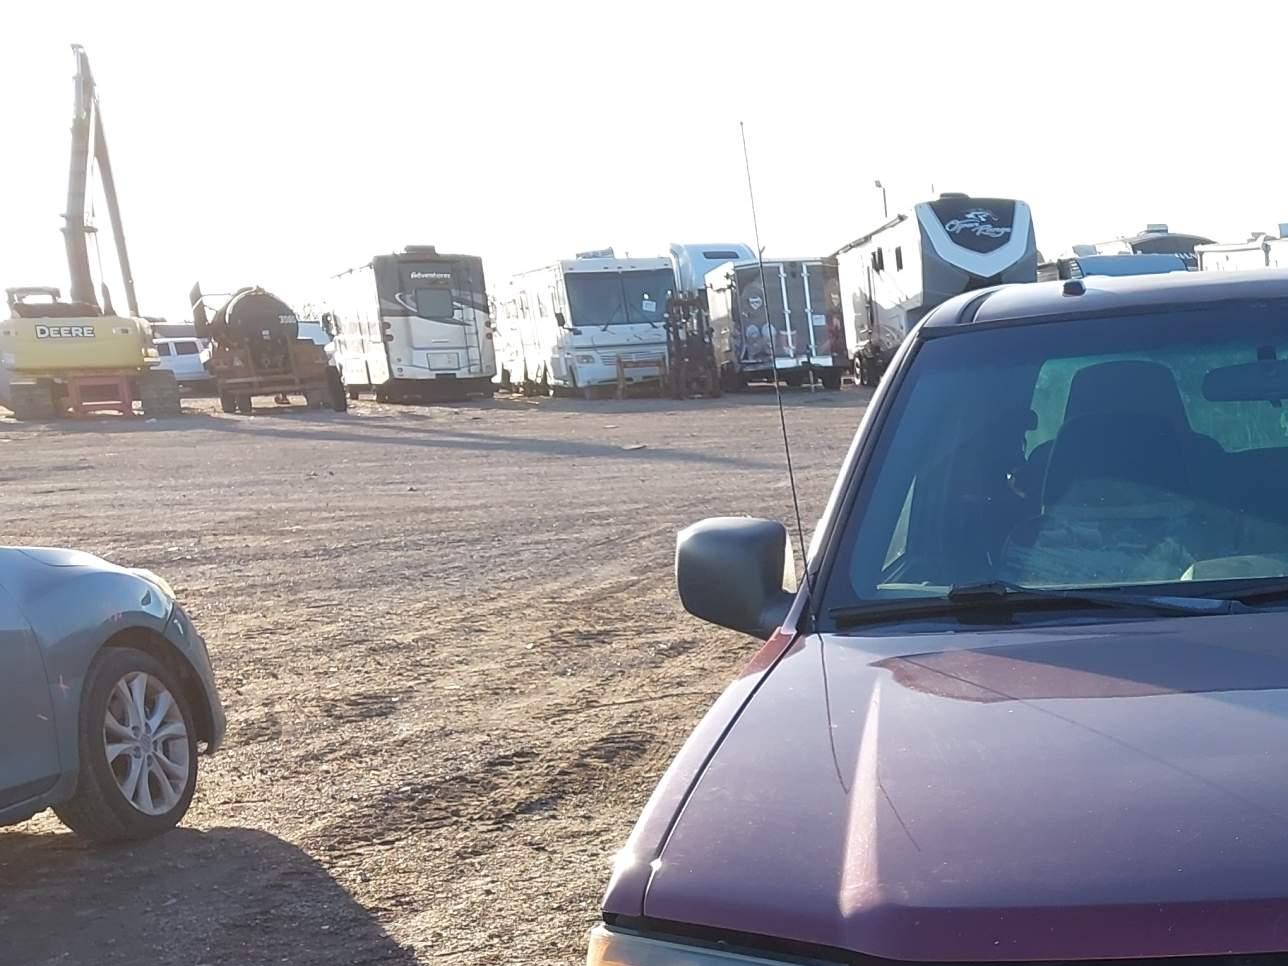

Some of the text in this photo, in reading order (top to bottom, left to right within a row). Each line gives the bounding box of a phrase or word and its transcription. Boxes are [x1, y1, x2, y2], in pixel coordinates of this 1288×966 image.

[945, 219, 1011, 238] Open Range
[36, 325, 96, 338] DEERE
